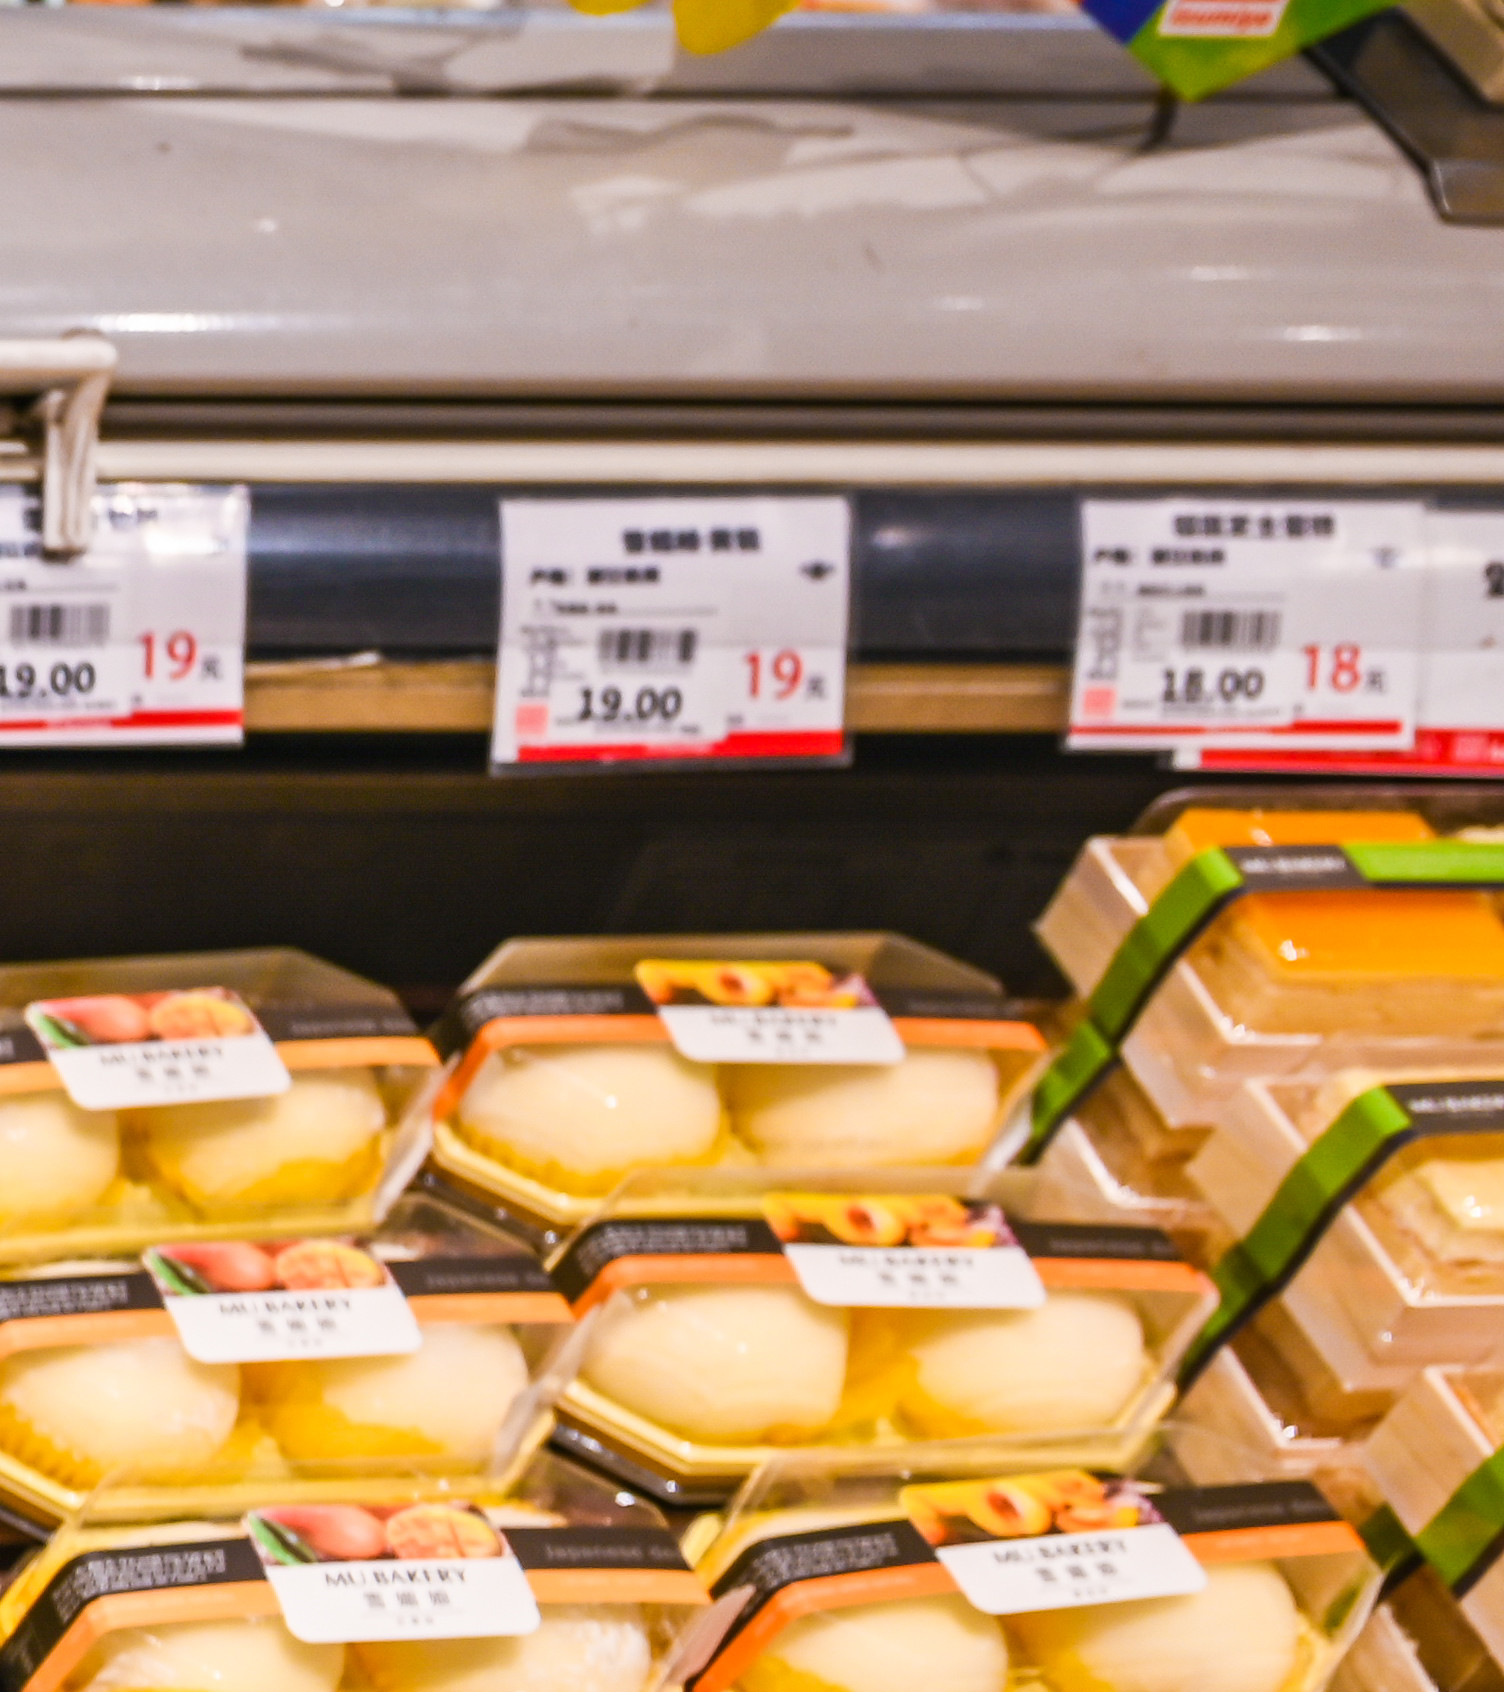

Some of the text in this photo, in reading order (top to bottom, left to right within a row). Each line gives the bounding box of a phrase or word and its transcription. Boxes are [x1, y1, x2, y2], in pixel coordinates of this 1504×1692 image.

[137, 630, 197, 682] 19
[742, 649, 803, 699] 19
[1301, 645, 1361, 692] 18
[578, 687, 684, 723] 19.00
[1162, 667, 1264, 704] 18.00
[324, 1566, 469, 1587] MU.BAKERY
